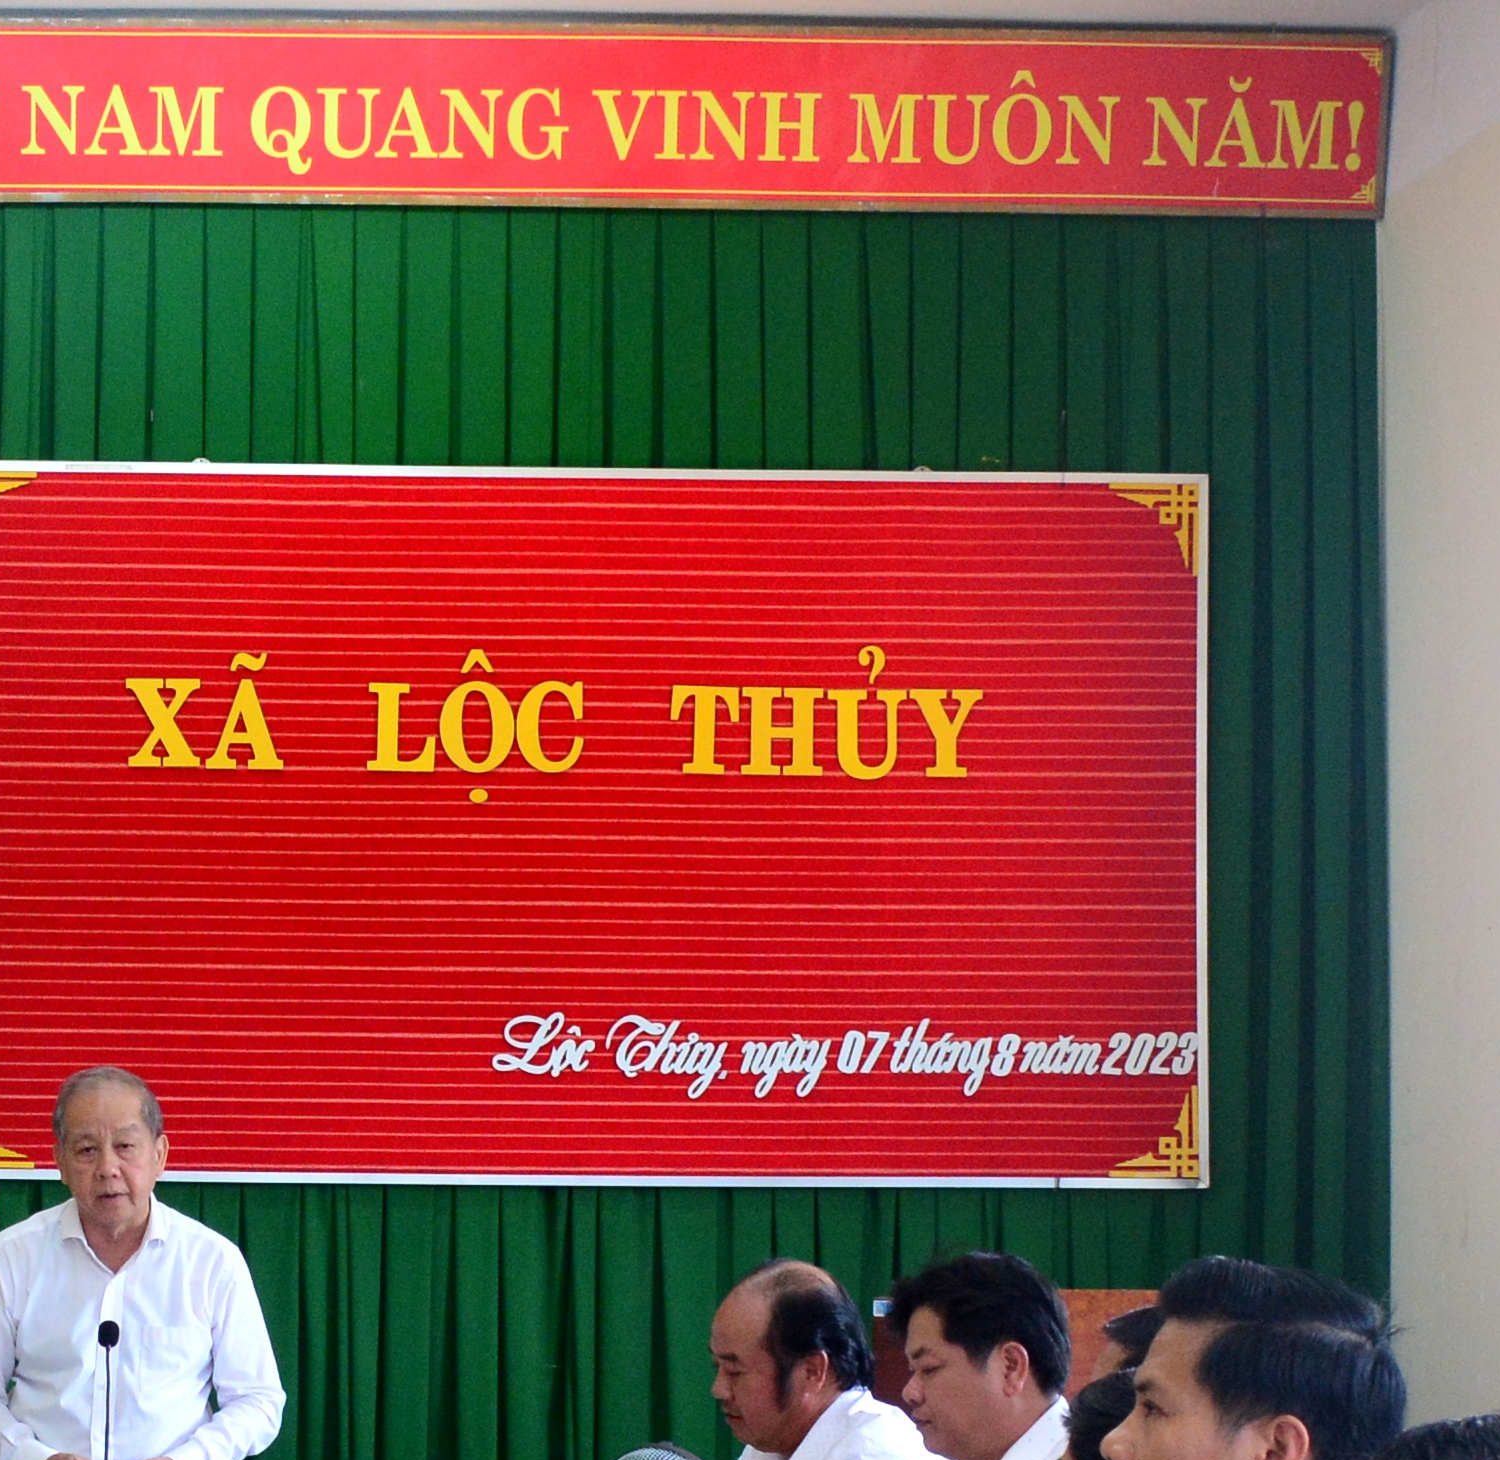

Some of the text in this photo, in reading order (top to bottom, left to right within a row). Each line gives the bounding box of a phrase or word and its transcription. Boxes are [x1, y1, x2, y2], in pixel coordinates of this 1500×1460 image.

[22, 85, 224, 156] NAM
[251, 86, 569, 174] QUANG
[593, 90, 822, 161] VINH
[848, 71, 1119, 164] MUÔN
[1145, 79, 1363, 170] NĂM!
[126, 646, 983, 803] XÃ LỘC THỦY
[491, 1011, 595, 1078] Lộc
[740, 1033, 832, 1099] ngày
[836, 1030, 890, 1074] 07
[889, 1018, 993, 1097] tháng
[990, 1033, 1021, 1076] 8
[1019, 1035, 1101, 1076] năm
[1101, 1032, 1198, 1076] 2023
